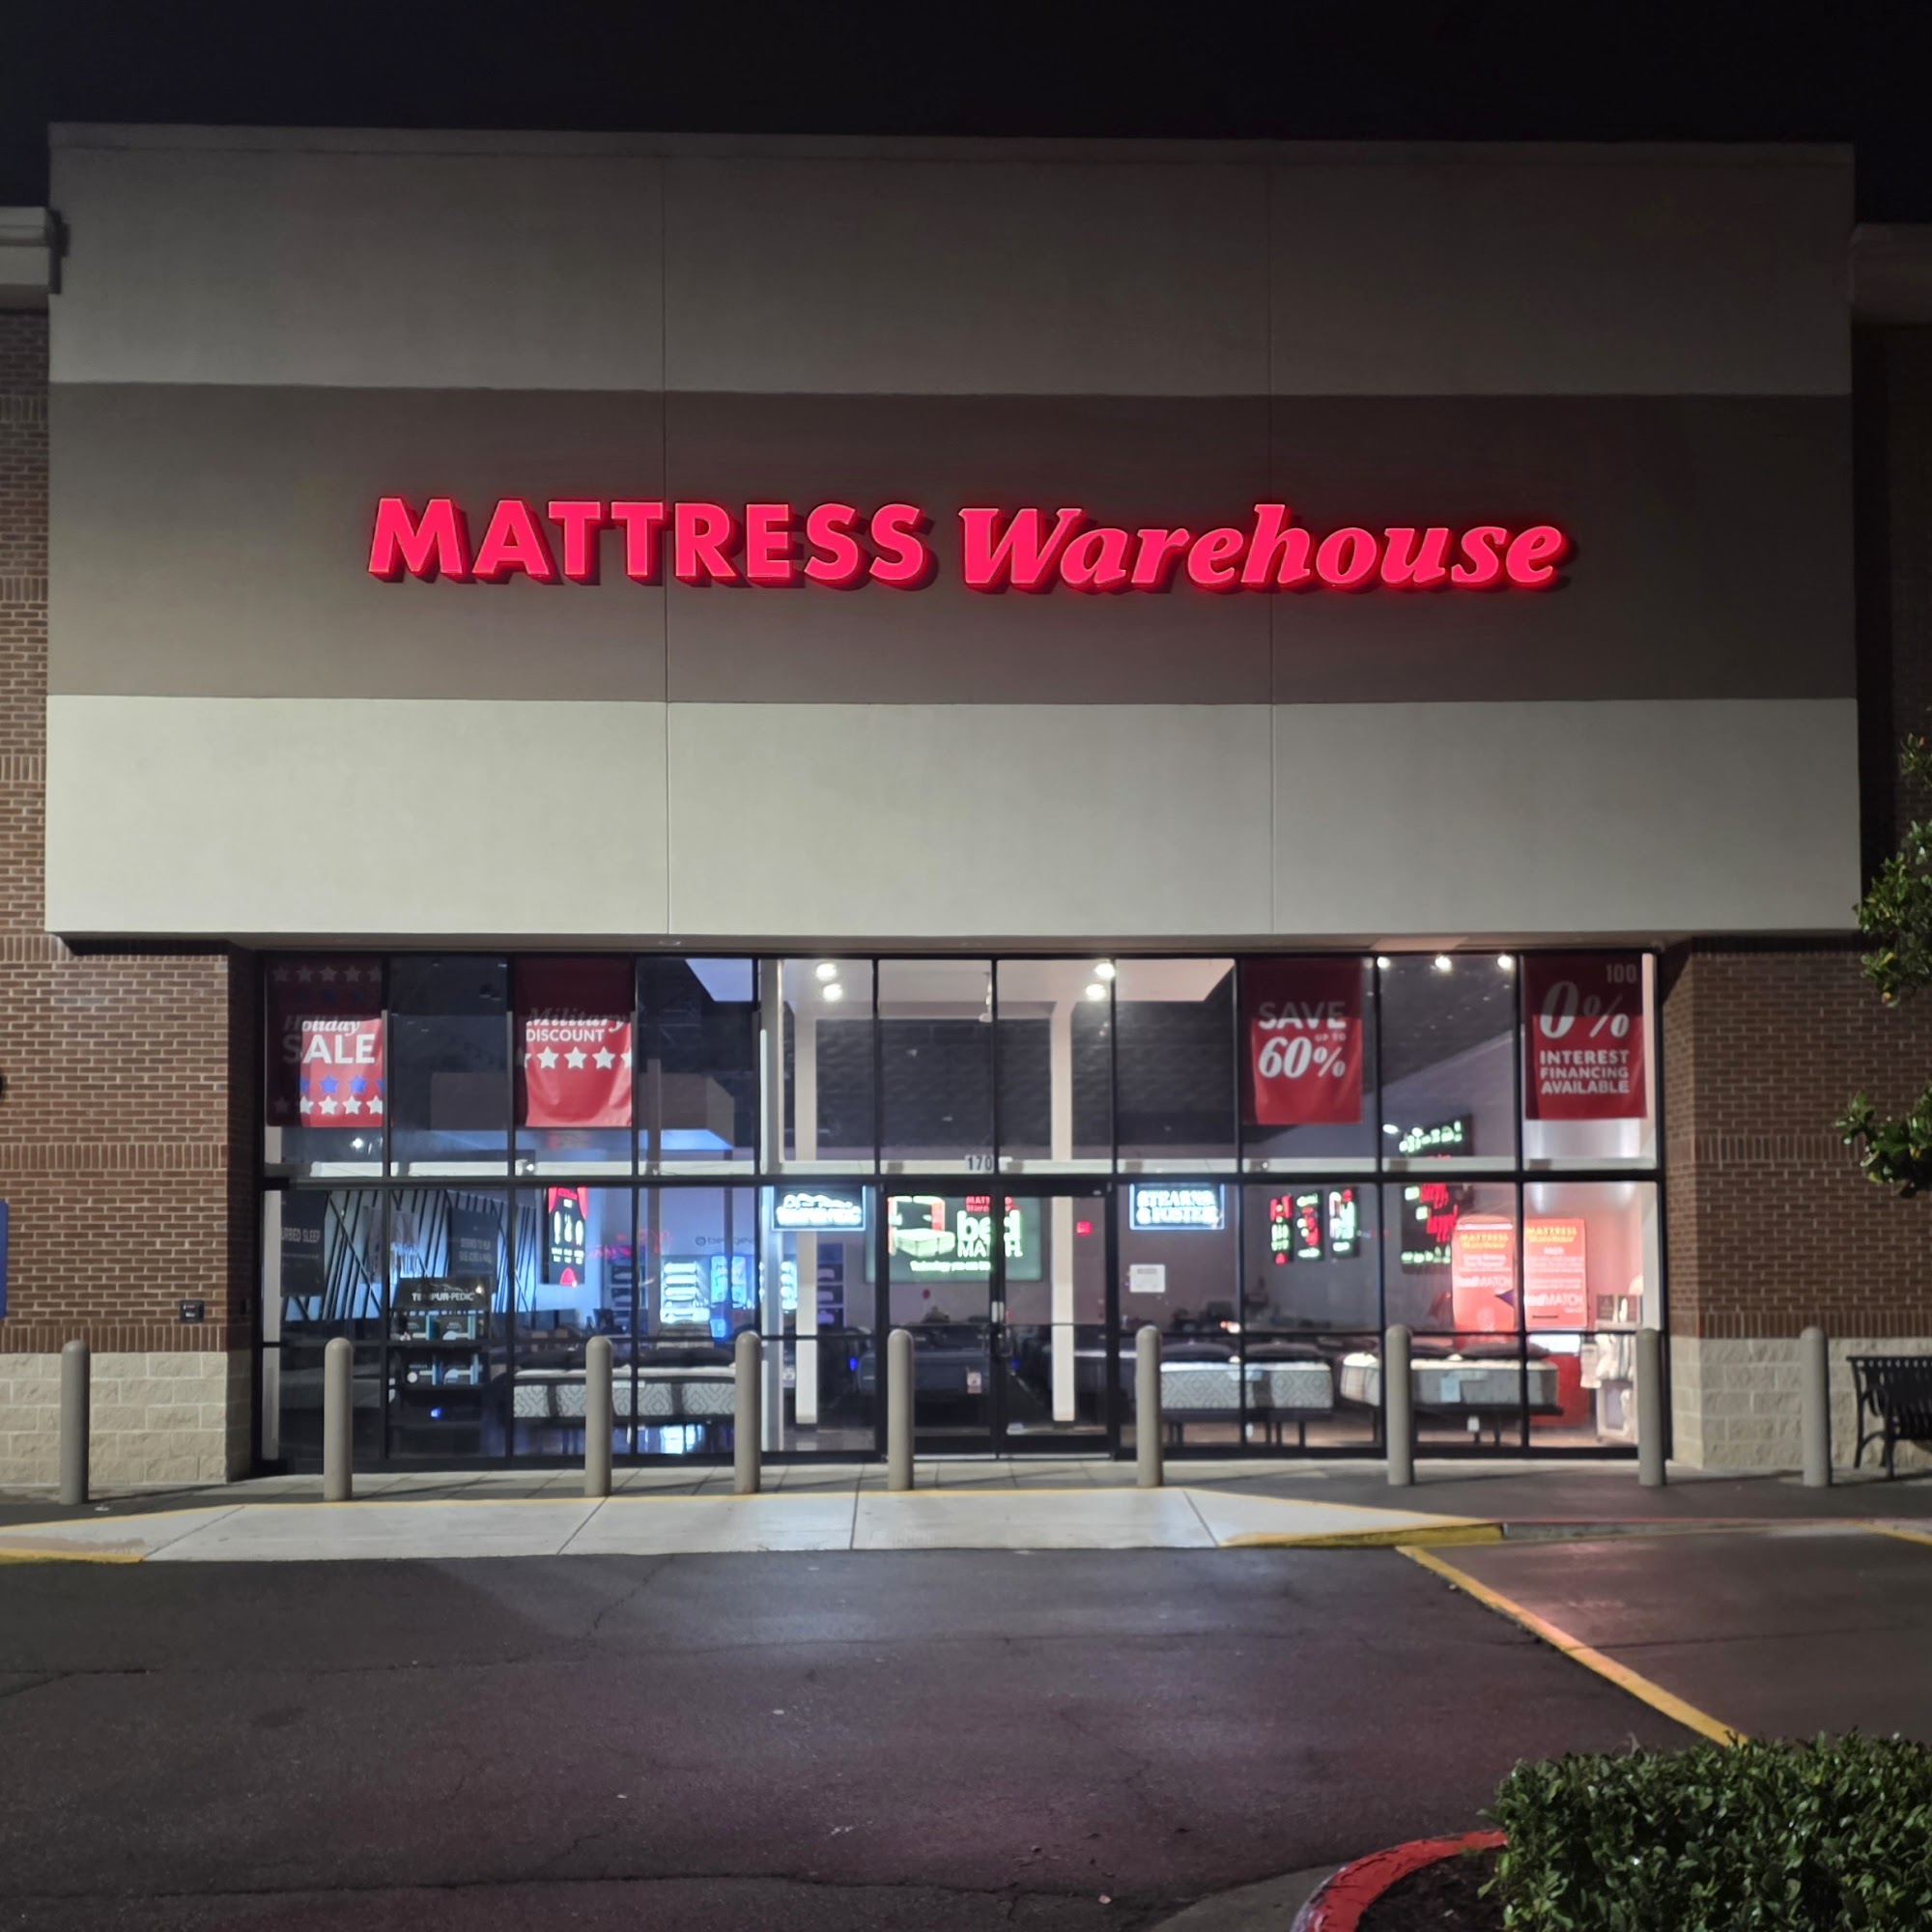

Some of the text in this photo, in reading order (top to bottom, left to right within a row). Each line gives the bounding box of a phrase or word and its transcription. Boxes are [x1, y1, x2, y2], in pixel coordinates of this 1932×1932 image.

[368, 497, 1563, 585] MATTRESS Warehouse
[1605, 963, 1638, 983] 100
[1259, 1001, 1347, 1031] SAVE
[1540, 980, 1630, 1038] 0%
[284, 1013, 362, 1037] Holiday
[526, 1008, 628, 1033] Military
[526, 1029, 606, 1042] DISCOUNT
[1315, 1032, 1347, 1042] UP TO
[282, 1033, 376, 1065] SALE
[1259, 1036, 1346, 1079] 60%
[1540, 1050, 1631, 1065] INTEREST
[1540, 1065, 1630, 1080] FINANCING
[1541, 1080, 1631, 1094] AVAILABLE
[967, 1156, 993, 1171] 170
